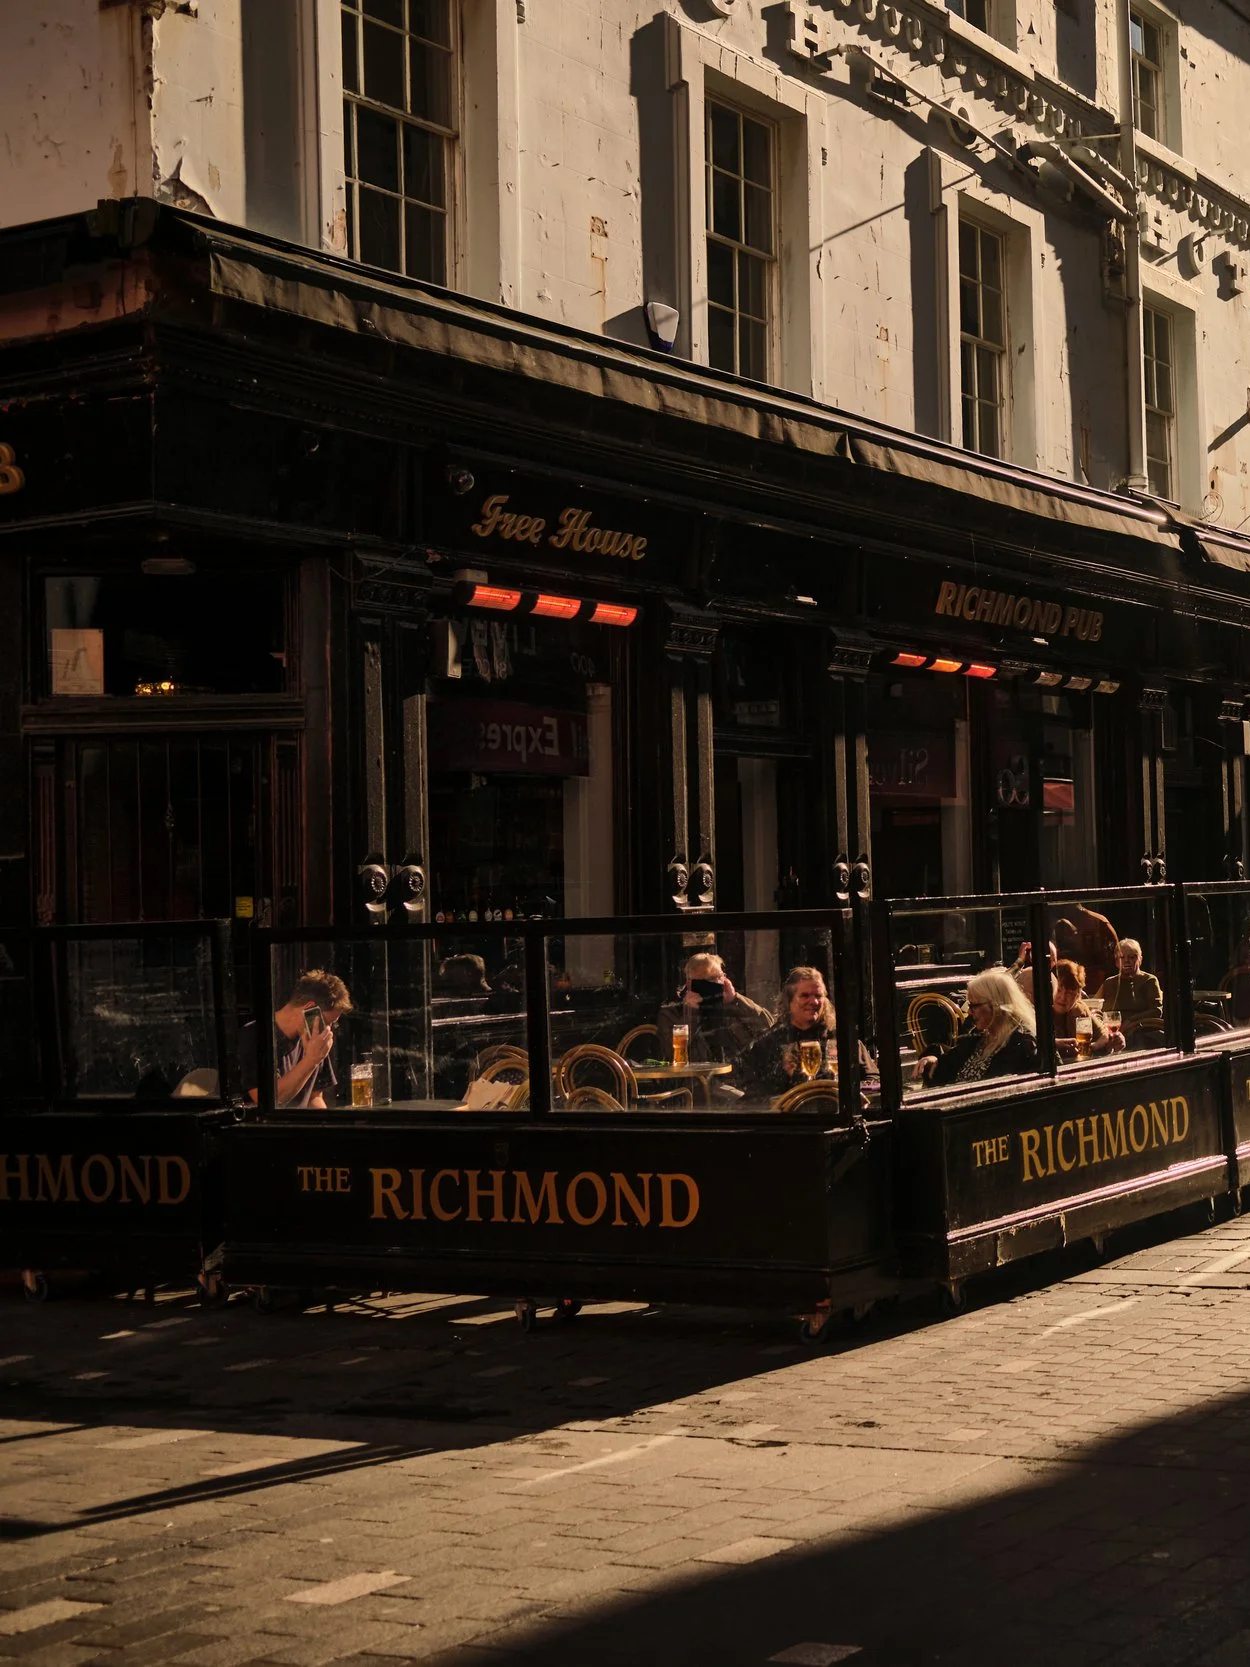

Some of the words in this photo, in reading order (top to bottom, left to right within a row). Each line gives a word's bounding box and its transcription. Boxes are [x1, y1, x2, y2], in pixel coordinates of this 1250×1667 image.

[471, 494, 546, 544] Free
[548, 507, 648, 561] House
[935, 581, 1063, 634] RICHMOND
[1061, 606, 1104, 642] PUB
[972, 1134, 1010, 1168] THE
[1020, 1096, 1189, 1182] RICHMOND
[0, 1153, 192, 1205] HMOND
[297, 1166, 352, 1193] THE
[368, 1167, 700, 1228] RICHMOND
